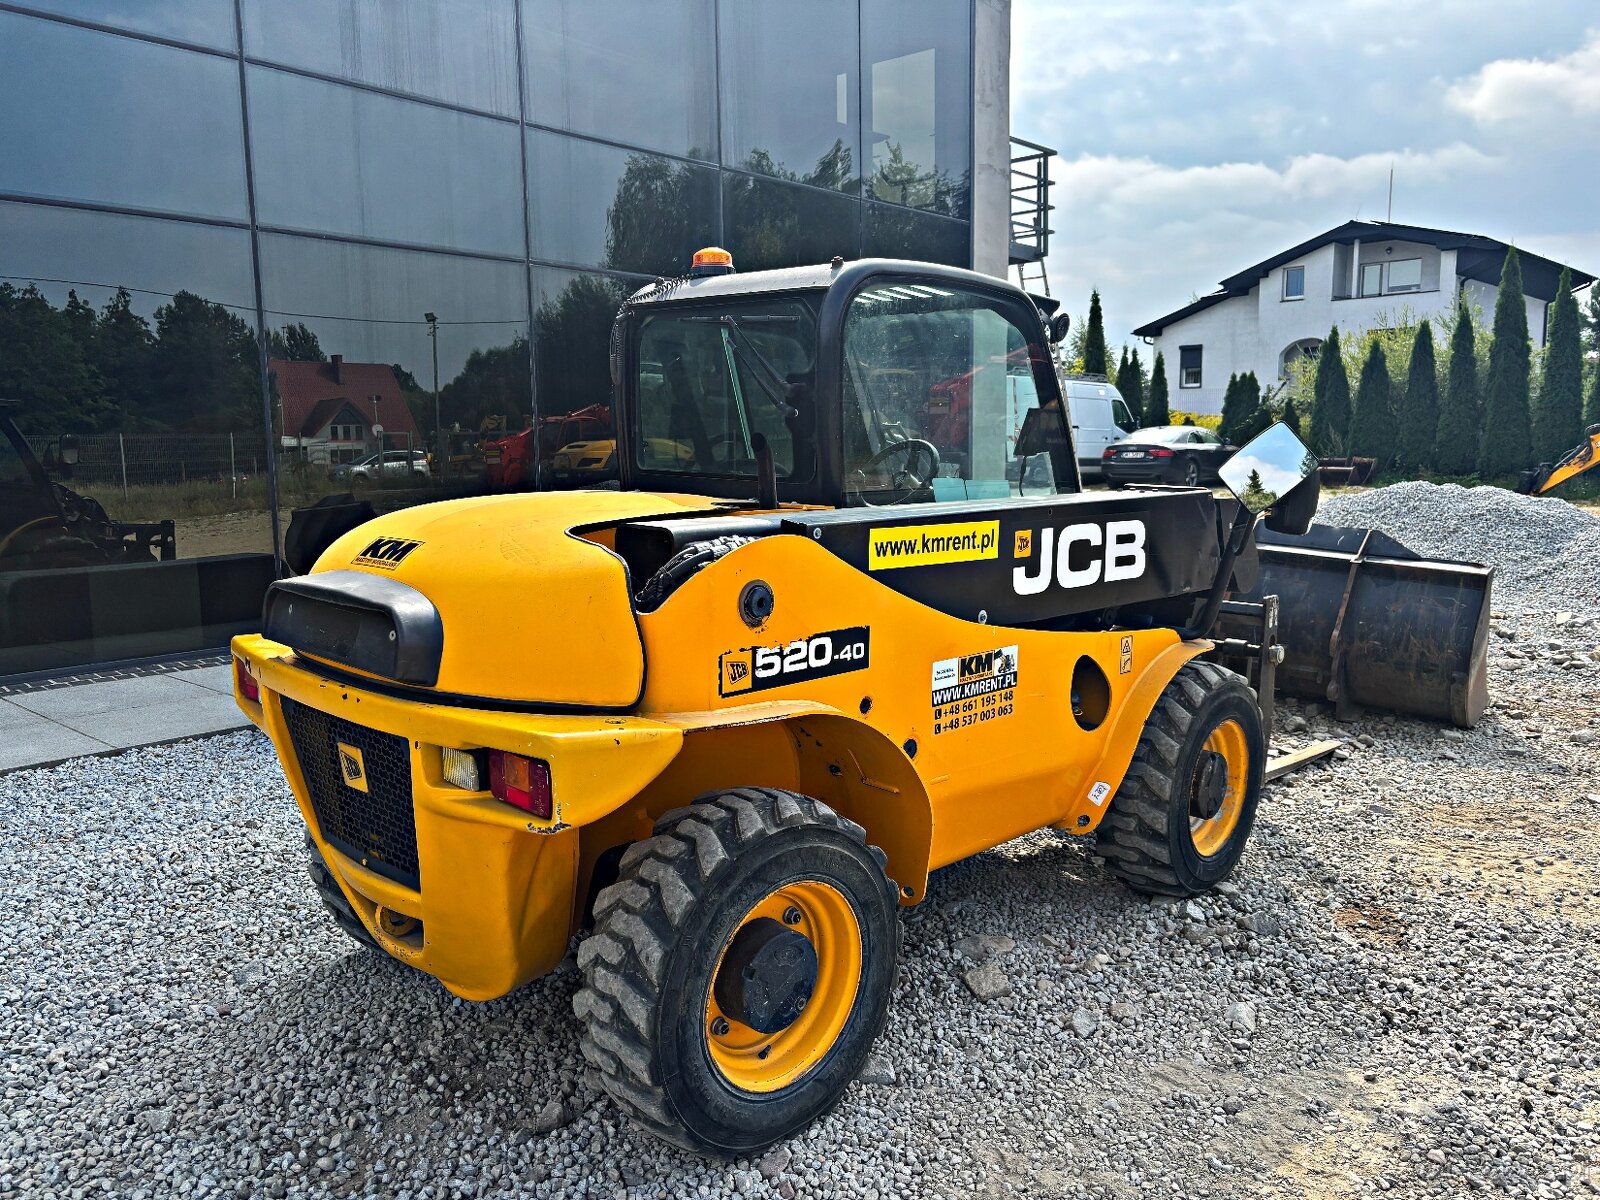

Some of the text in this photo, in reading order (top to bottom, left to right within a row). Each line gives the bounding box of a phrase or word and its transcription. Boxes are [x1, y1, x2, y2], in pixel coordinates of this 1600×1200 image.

[360, 538, 420, 562] KM
[874, 528, 995, 557] www.kmrent.pl
[1013, 520, 1146, 595] JCB
[729, 636, 865, 682] JCB 520-40
[960, 652, 994, 677] KM
[932, 673, 1017, 705] WWW.KMRENT.PL
[943, 690, 1014, 717] +48 661 195 148
[943, 703, 1013, 732] +48 537 003 063
